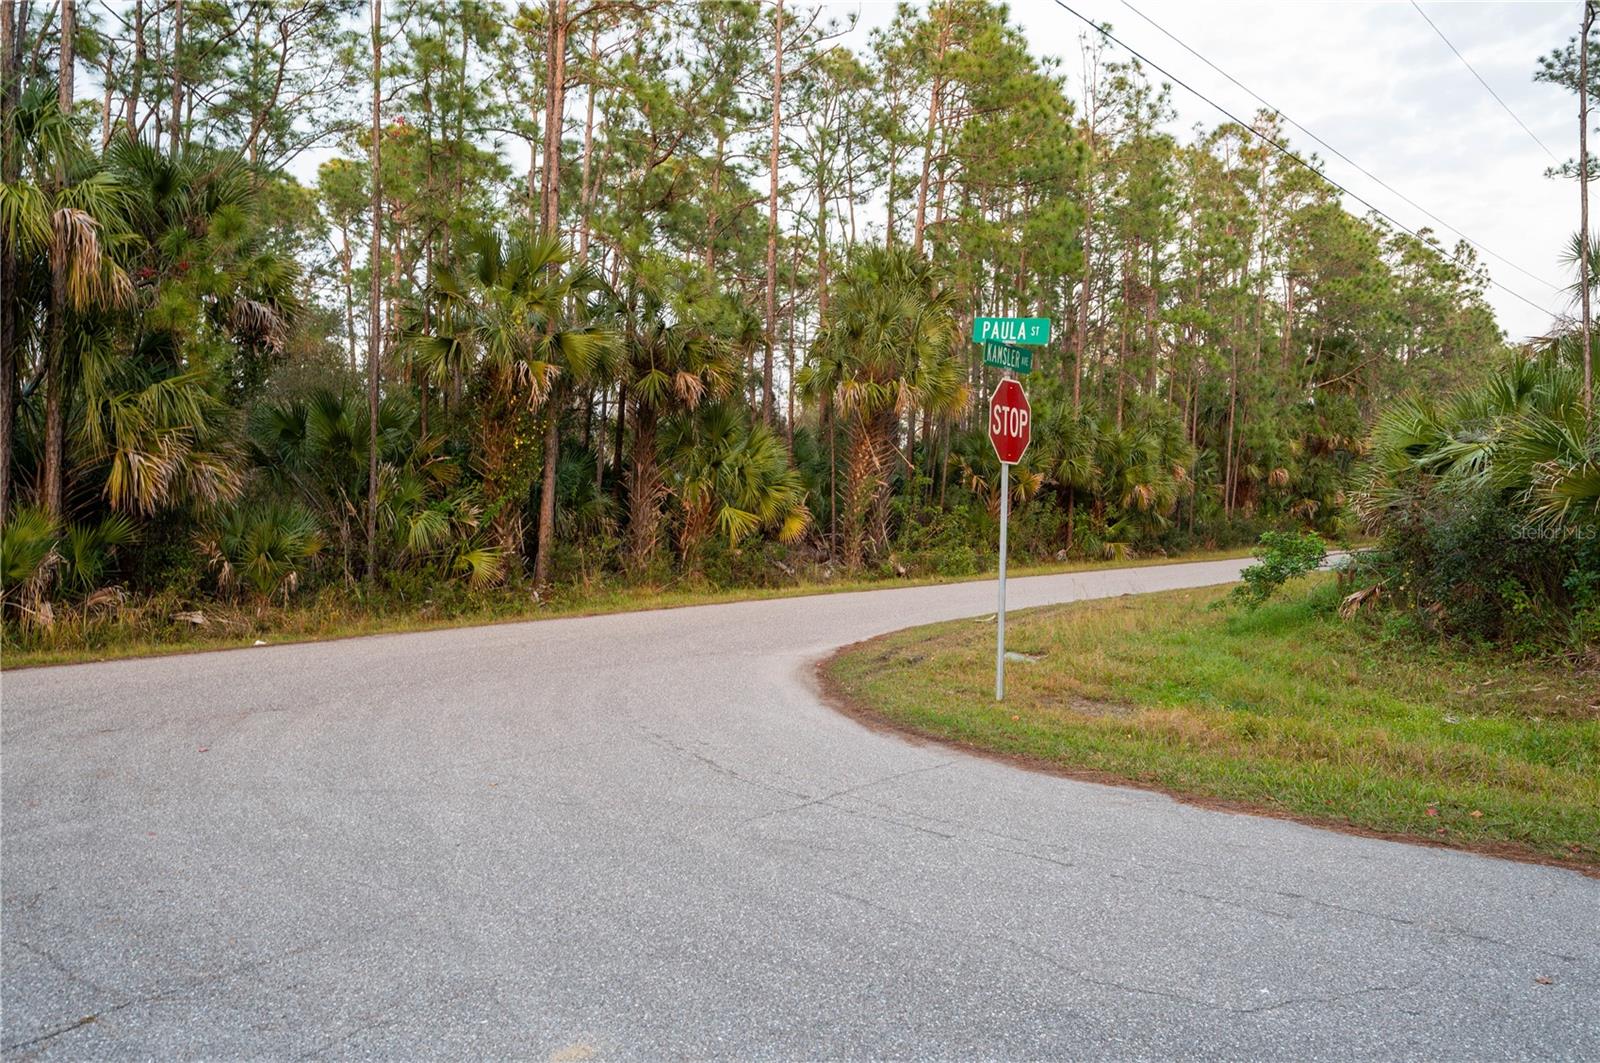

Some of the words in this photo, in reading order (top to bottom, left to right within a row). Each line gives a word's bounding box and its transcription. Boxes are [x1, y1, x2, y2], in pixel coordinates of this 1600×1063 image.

[982, 321, 1026, 340] PAULA
[1030, 326, 1040, 337] ST
[986, 343, 1020, 368] KAMSLER
[1021, 356, 1029, 367] AVE
[992, 404, 1028, 438] STOP
